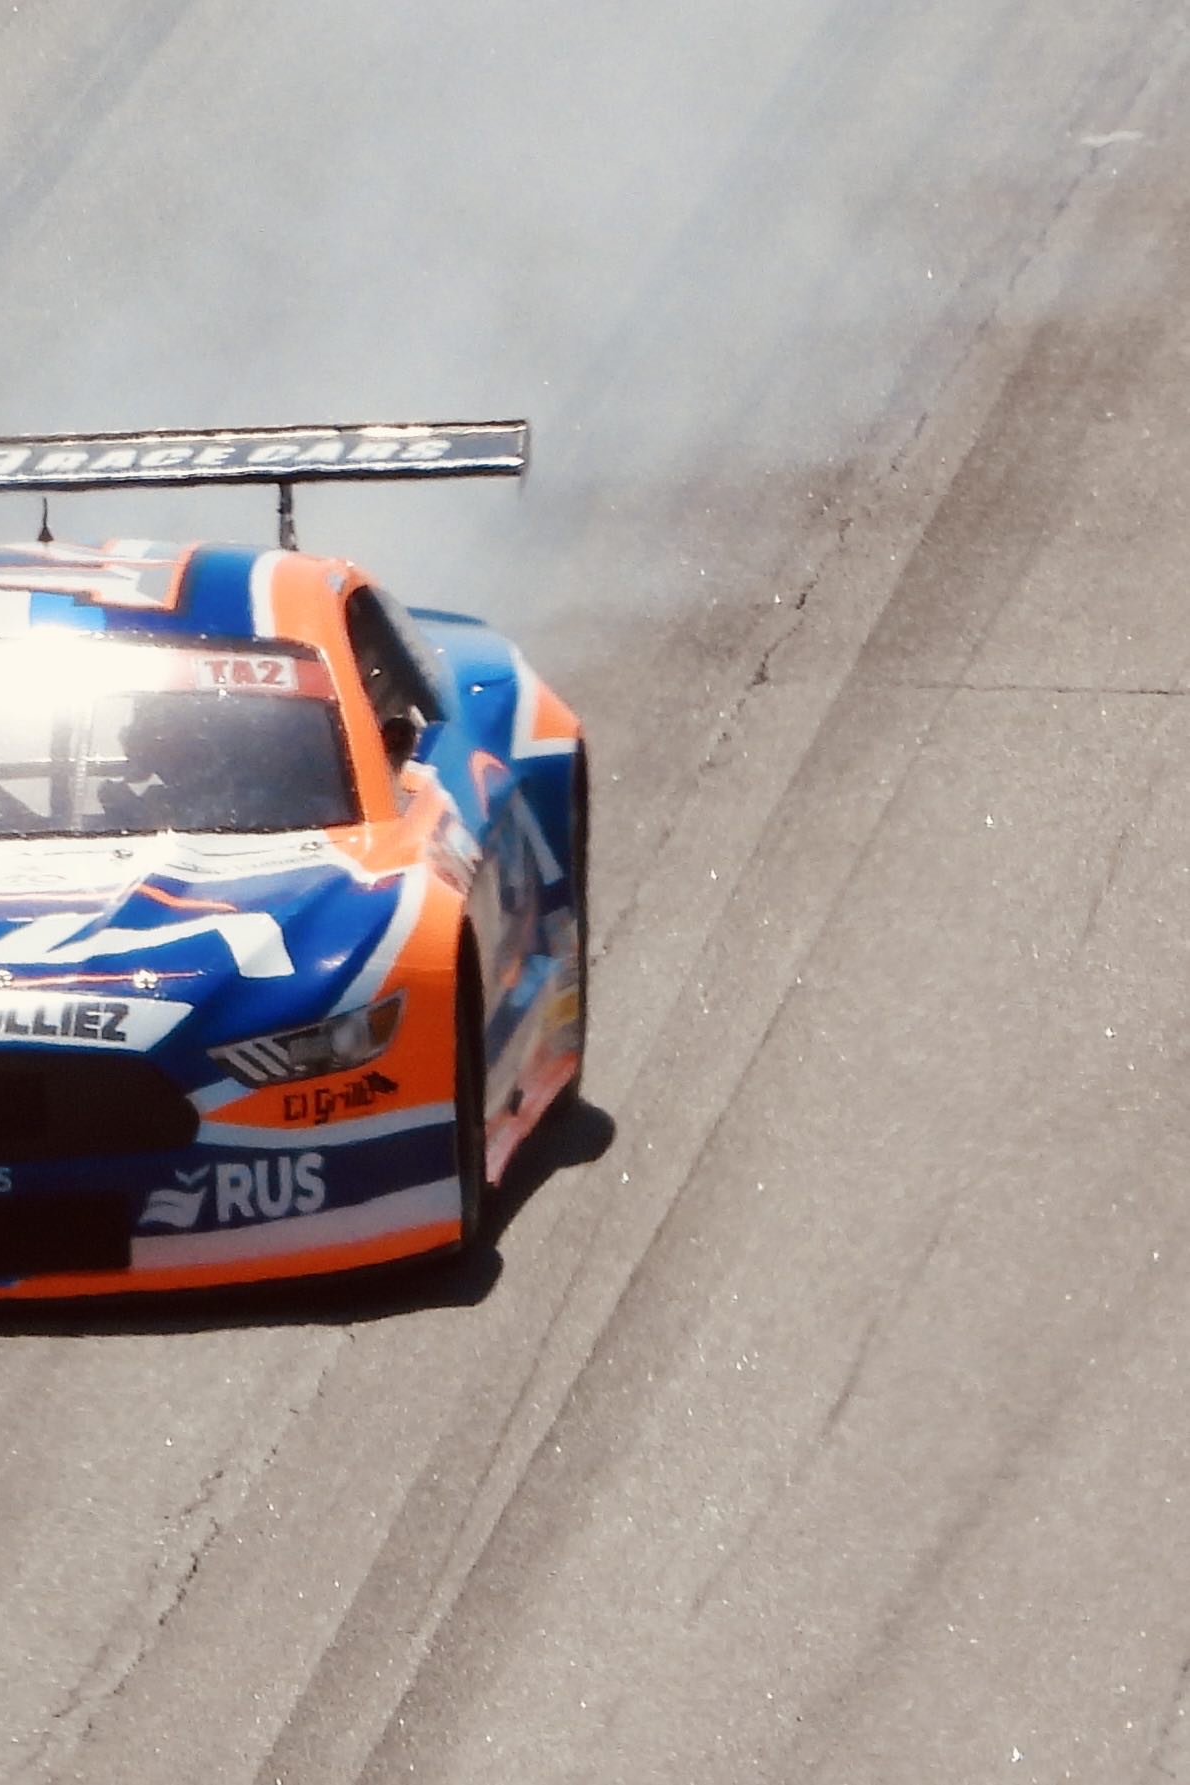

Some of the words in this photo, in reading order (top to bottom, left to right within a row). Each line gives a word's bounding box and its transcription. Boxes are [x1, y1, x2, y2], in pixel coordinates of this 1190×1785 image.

[35, 446, 237, 472] RACE
[247, 439, 452, 463] CARS
[204, 659, 285, 685] TA2
[215, 1151, 326, 1223] RUS
